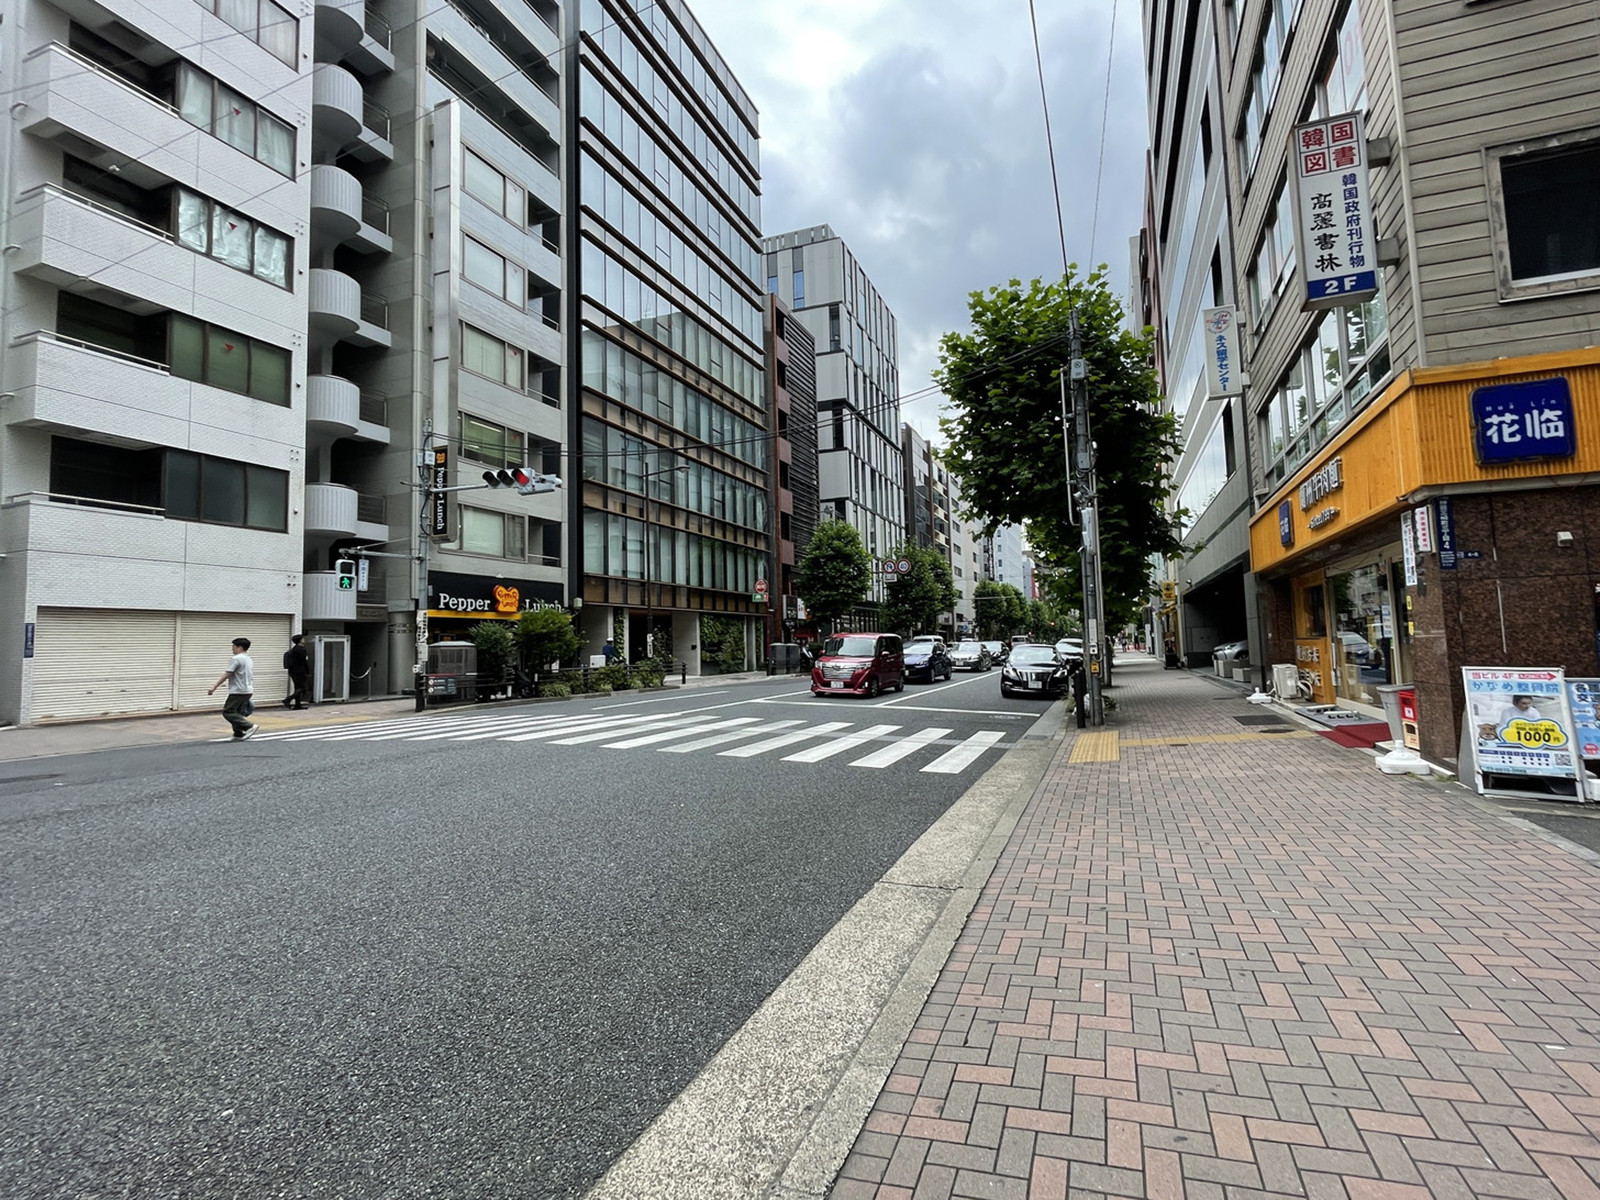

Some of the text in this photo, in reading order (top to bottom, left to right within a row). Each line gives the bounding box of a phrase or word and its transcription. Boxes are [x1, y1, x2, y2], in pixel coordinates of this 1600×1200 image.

[1301, 120, 1354, 149] 韓国
[1304, 145, 1356, 173] 図書
[1342, 173, 1365, 268] 韓国政府刊行物
[1324, 276, 1357, 294] 2F
[1484, 408, 1565, 444] 花临
[437, 467, 445, 530] Peppr Lunch
[438, 593, 491, 612] Pepper
